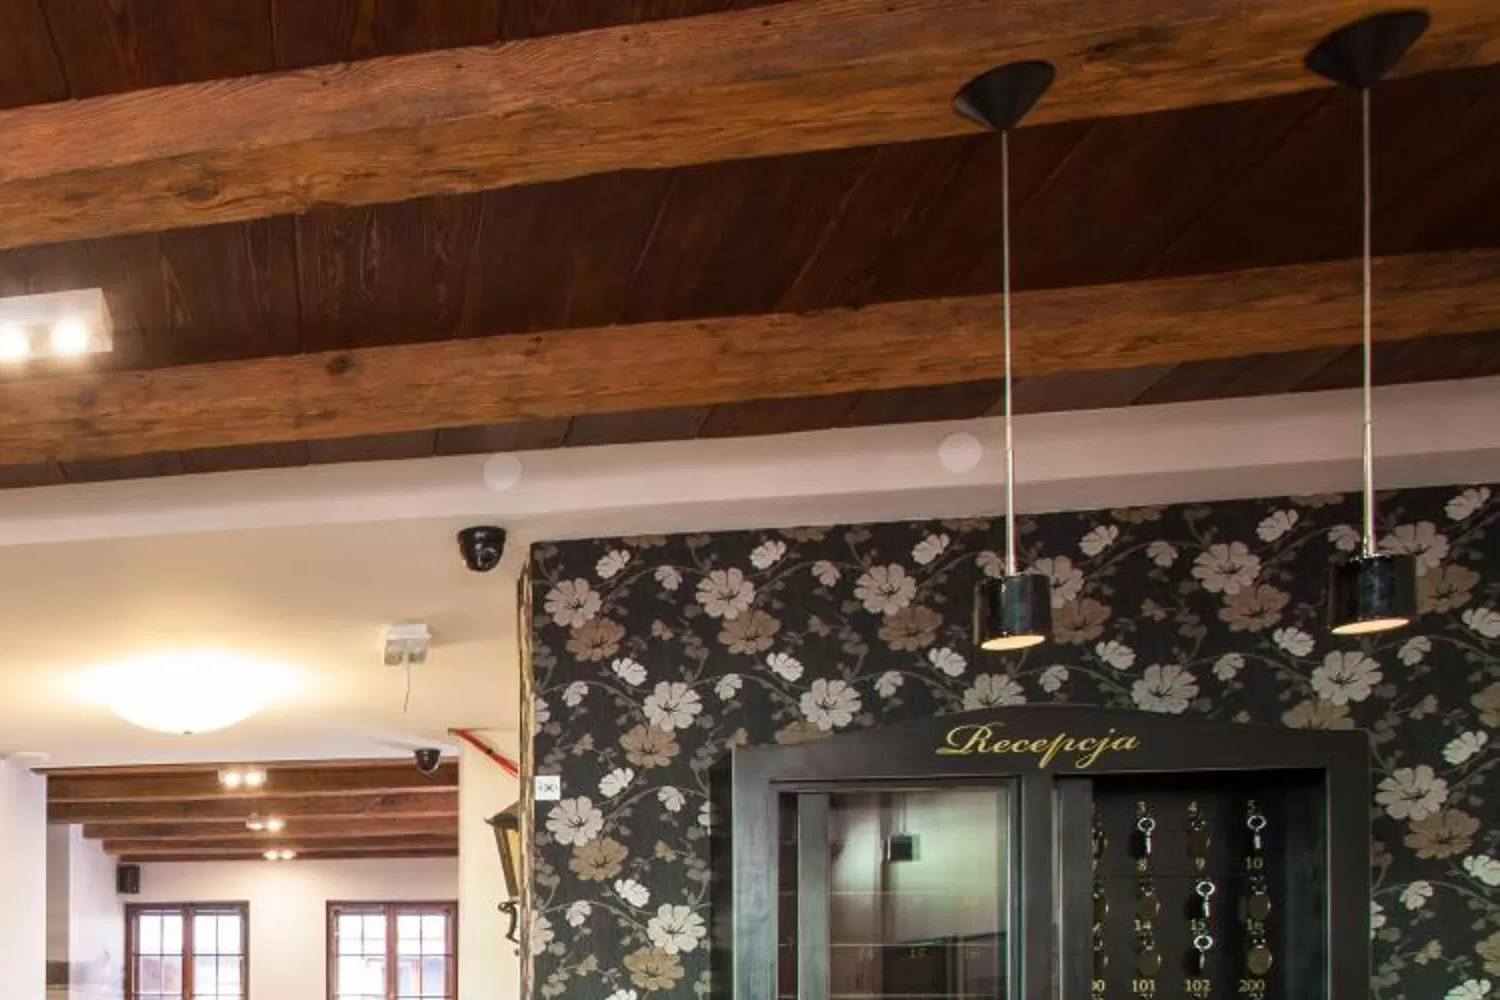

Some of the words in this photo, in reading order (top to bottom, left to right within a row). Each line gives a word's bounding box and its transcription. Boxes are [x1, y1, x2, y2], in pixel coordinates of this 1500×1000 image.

[935, 721, 1140, 769] Recepcja
[1137, 858, 1148, 872] 8
[1245, 857, 1264, 870] 10
[1133, 919, 1152, 931] 14
[1132, 979, 1157, 993] 101
[1185, 979, 1213, 993] 102
[1237, 979, 1266, 993] 200
